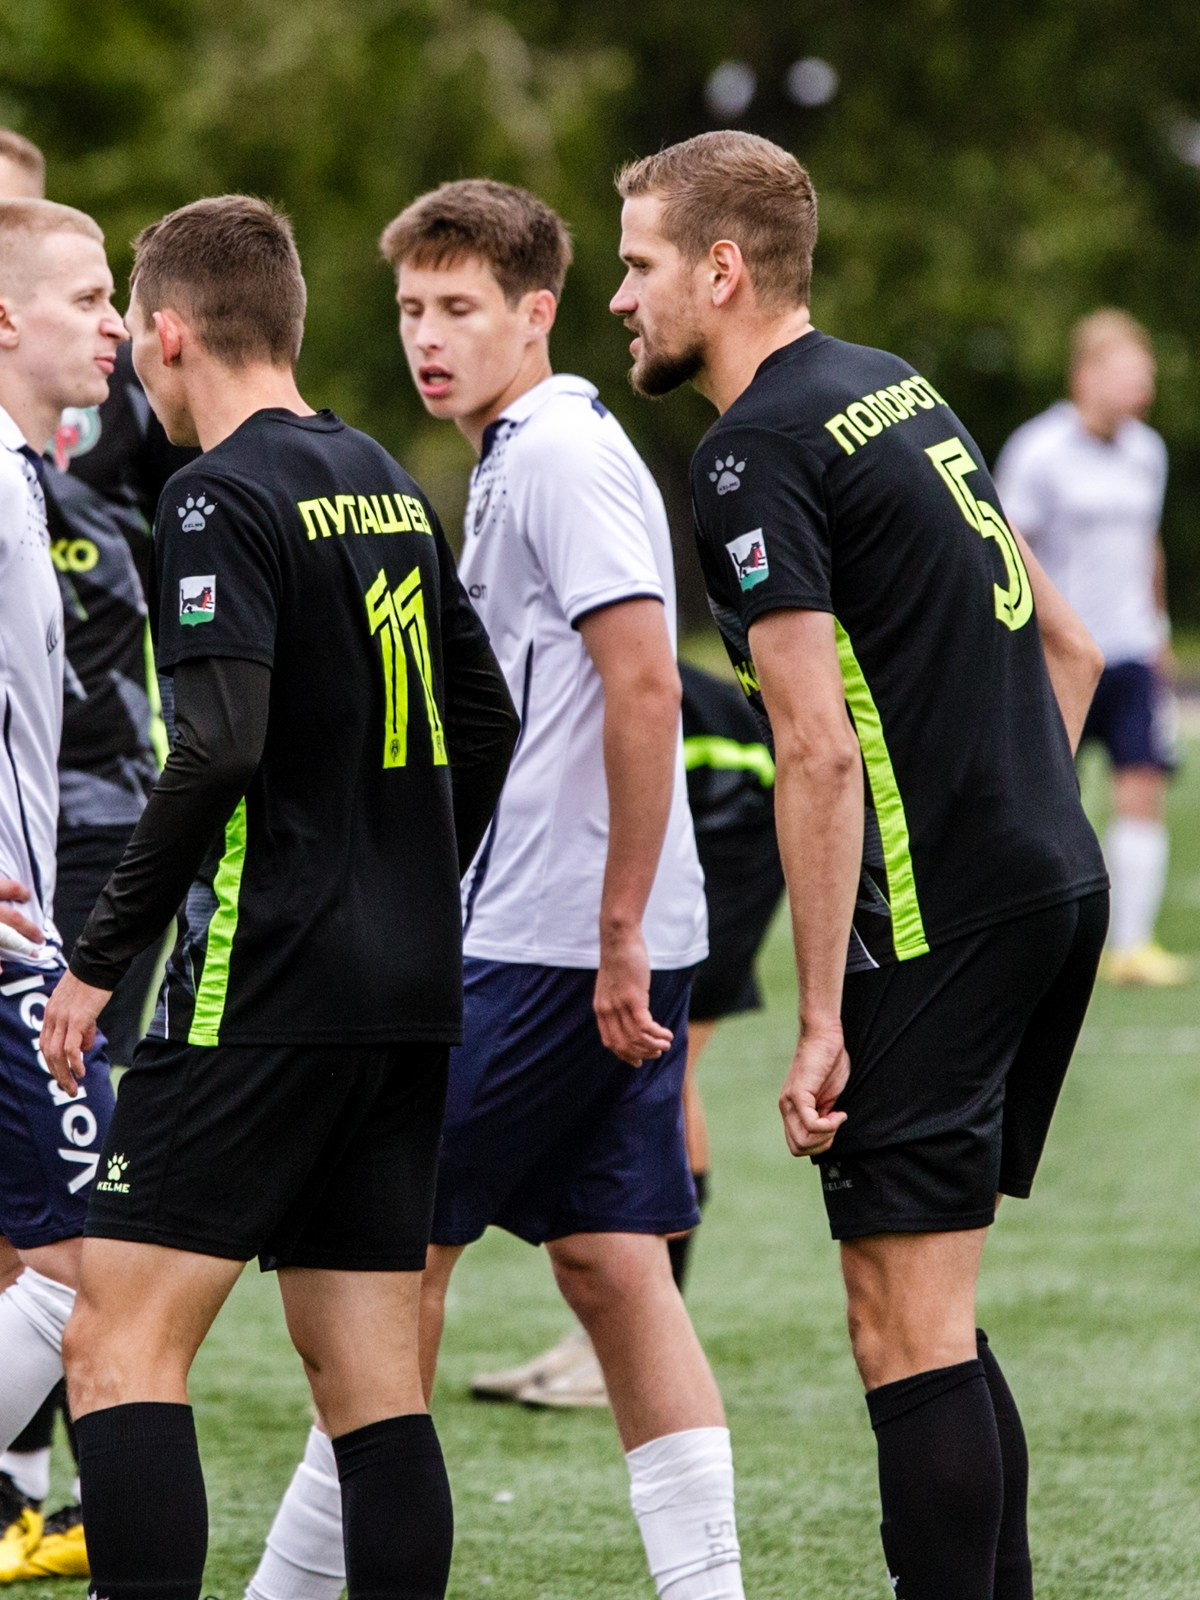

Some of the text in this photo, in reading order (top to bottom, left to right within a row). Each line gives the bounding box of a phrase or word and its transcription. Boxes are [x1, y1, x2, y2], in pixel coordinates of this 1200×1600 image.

[823, 375, 949, 456] ПОЛОРОТ
[923, 436, 1035, 632] 5
[364, 566, 449, 770] 11
[97, 1180, 131, 1194] KELME
